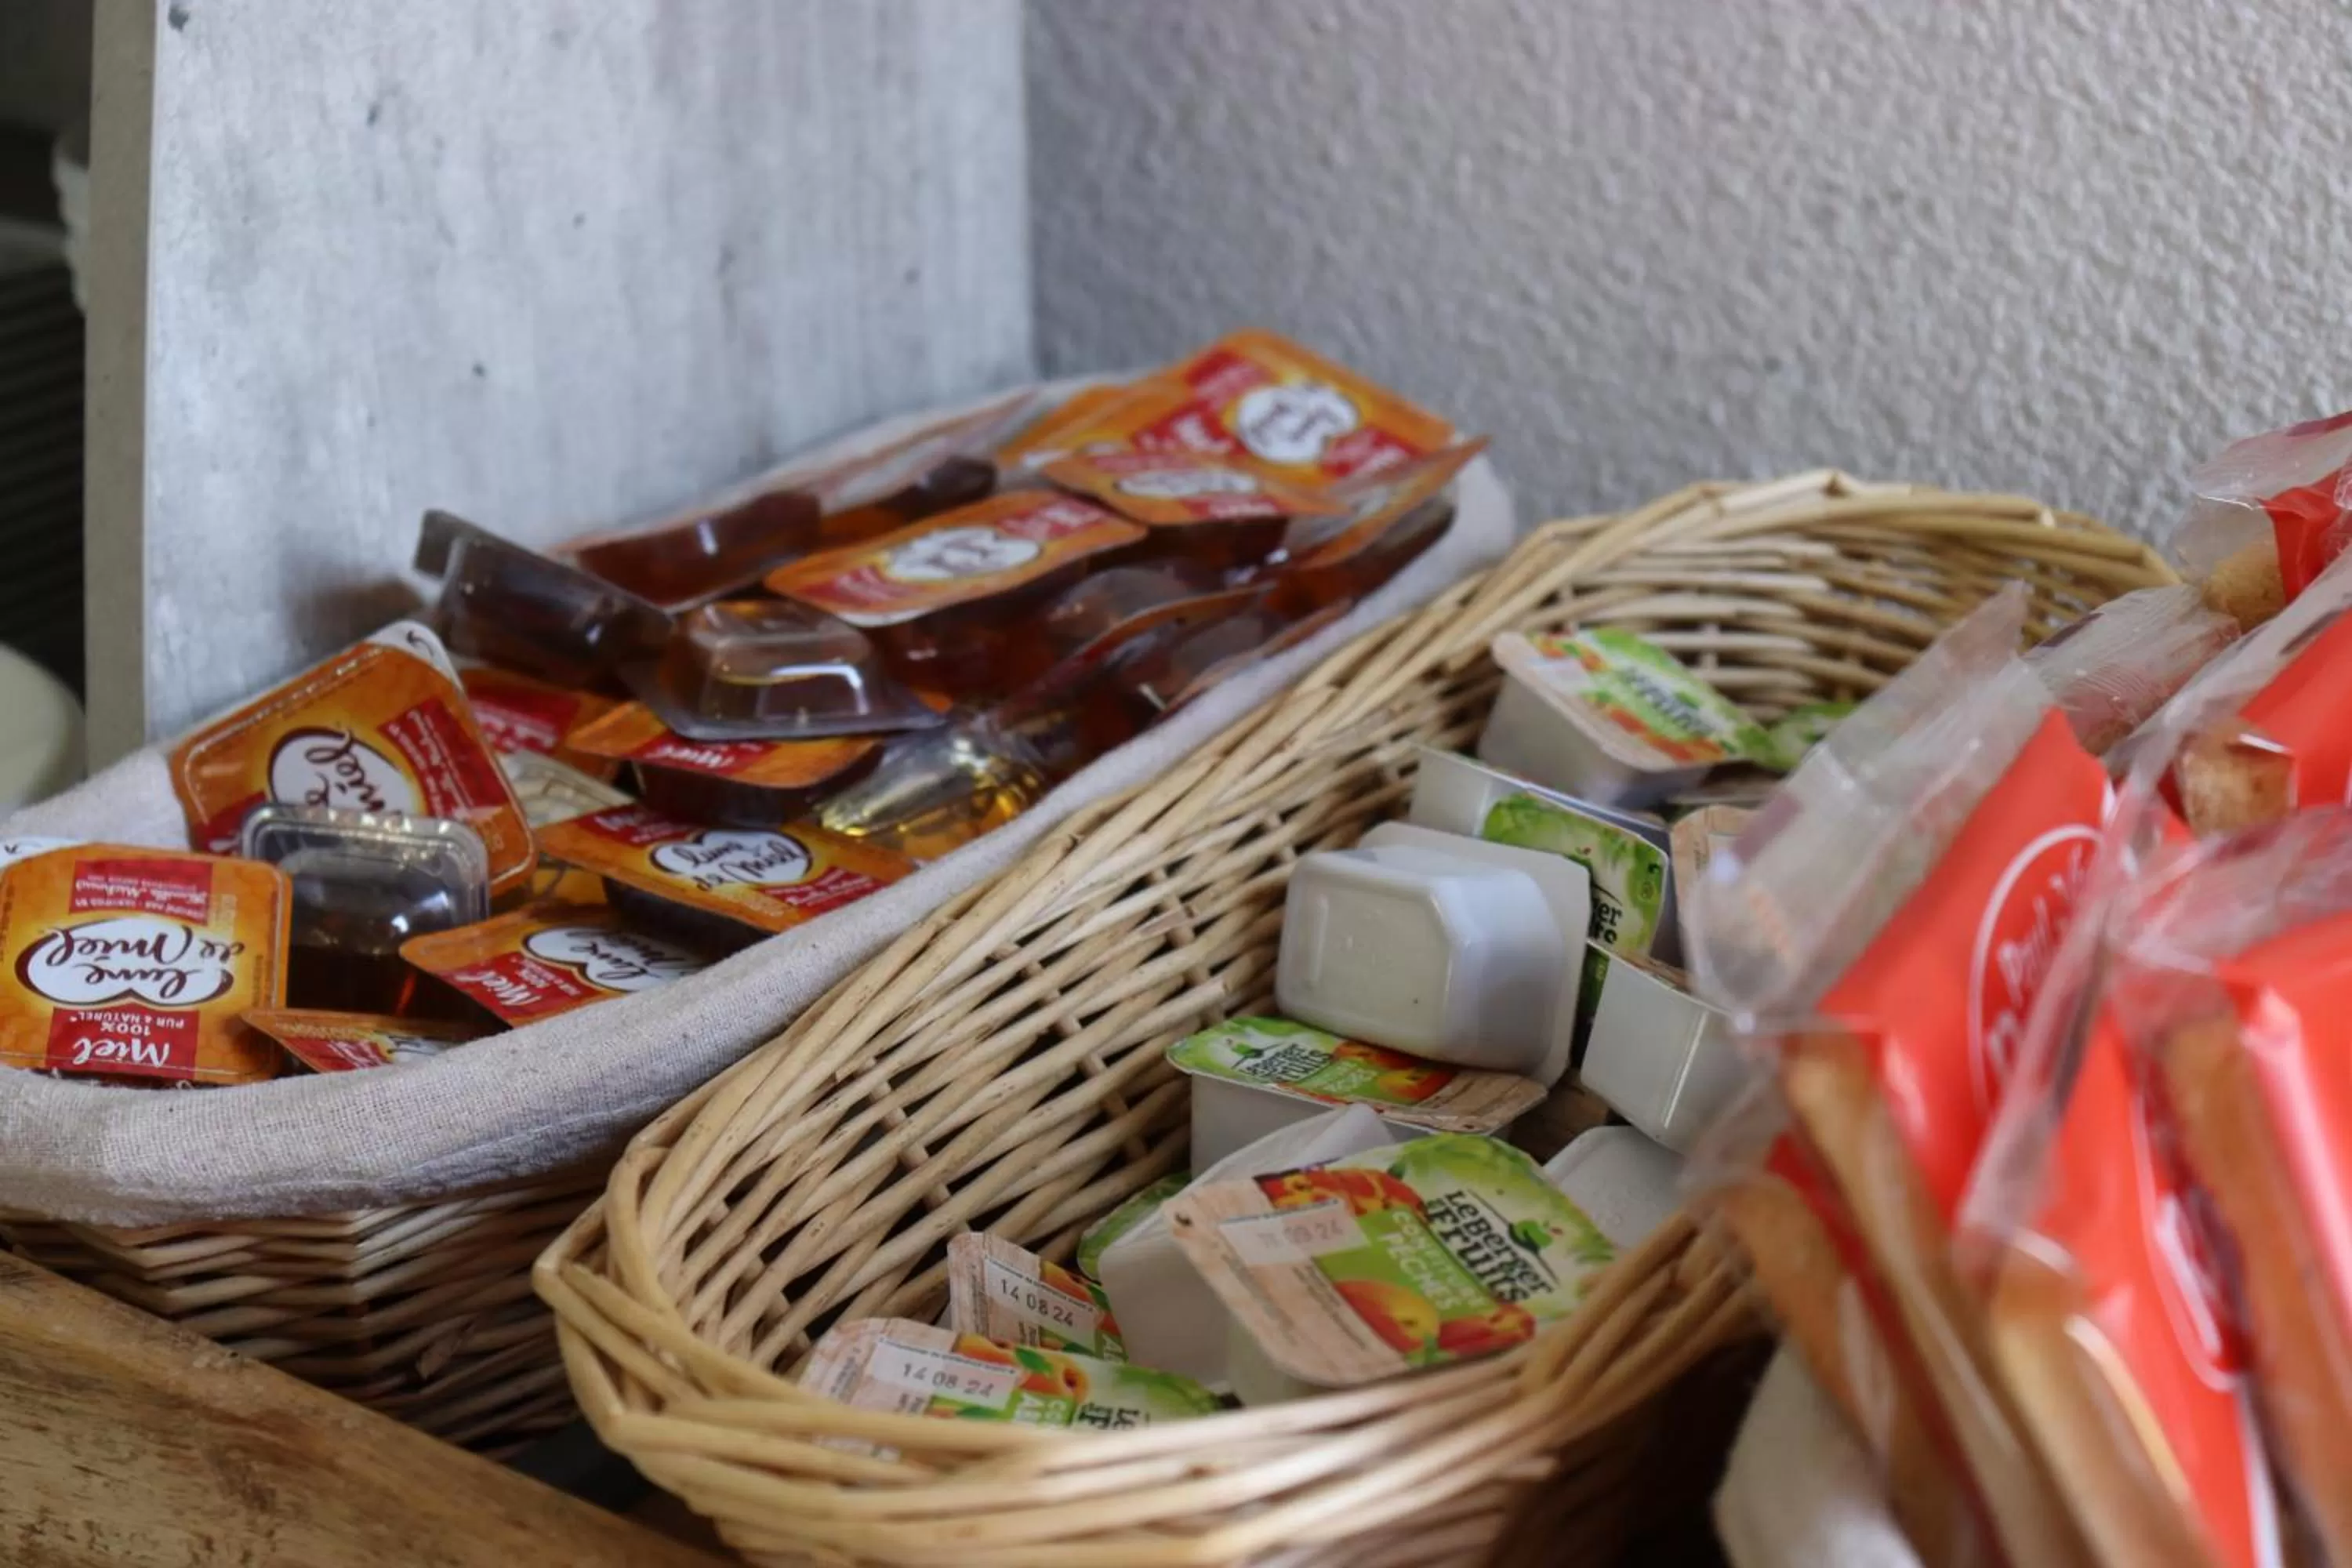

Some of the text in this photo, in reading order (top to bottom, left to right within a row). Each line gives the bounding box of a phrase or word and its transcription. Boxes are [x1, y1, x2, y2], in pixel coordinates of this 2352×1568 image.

[198, 939, 245, 964] de
[100, 1021, 151, 1036] 100%
[156, 1018, 185, 1029] PUR
[72, 1036, 171, 1068] Miel
[1001, 1279, 1019, 1303] 14
[1025, 1293, 1049, 1316] 08
[1052, 1305, 1074, 1327] 24
[902, 1363, 995, 1399] 14 08 24
